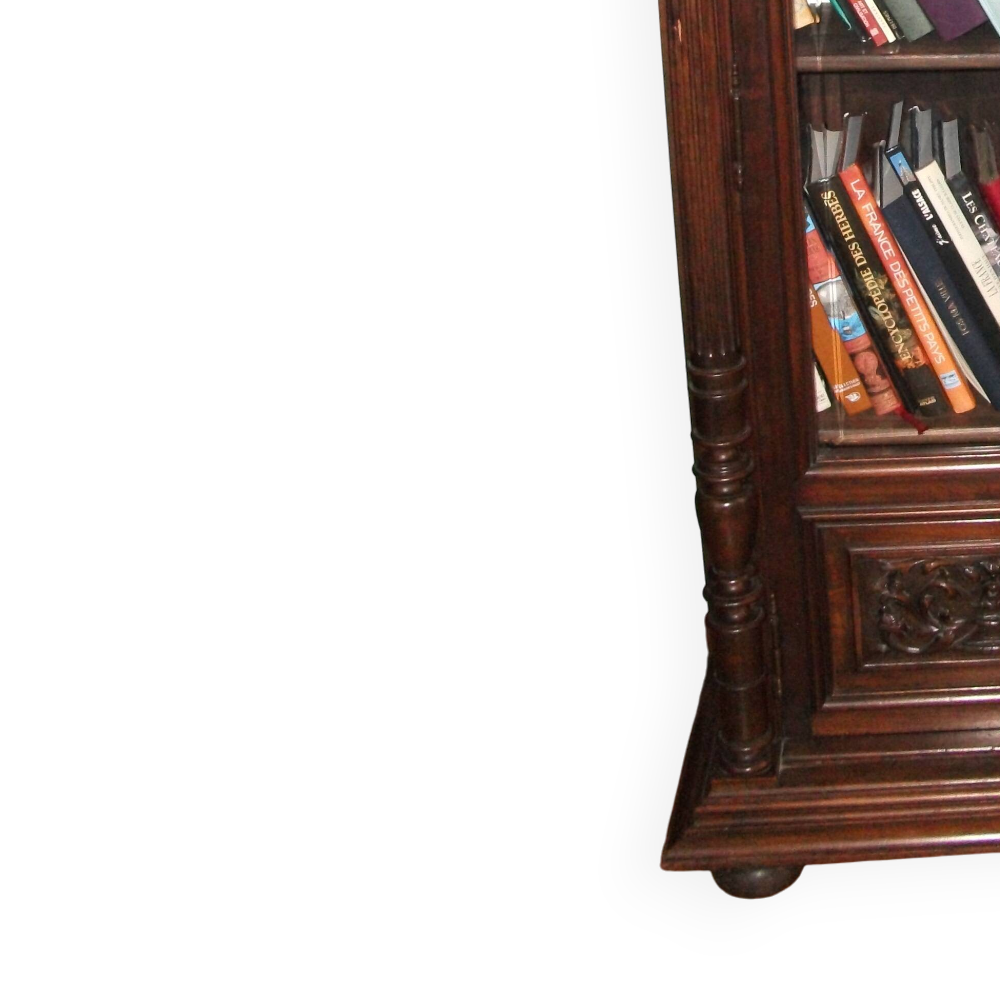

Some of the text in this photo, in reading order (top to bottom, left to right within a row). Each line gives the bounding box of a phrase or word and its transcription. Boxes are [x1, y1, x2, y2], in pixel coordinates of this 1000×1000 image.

[856, 0, 864, 9] ART
[910, 187, 934, 221] L'ALSACE
[960, 191, 979, 214] LES
[820, 188, 913, 362] ENCYCLOPÉDIE DES HERBES
[849, 178, 946, 364] LA FRANCE DES PETITS PAYS
[969, 257, 998, 297] LA FRANCE
